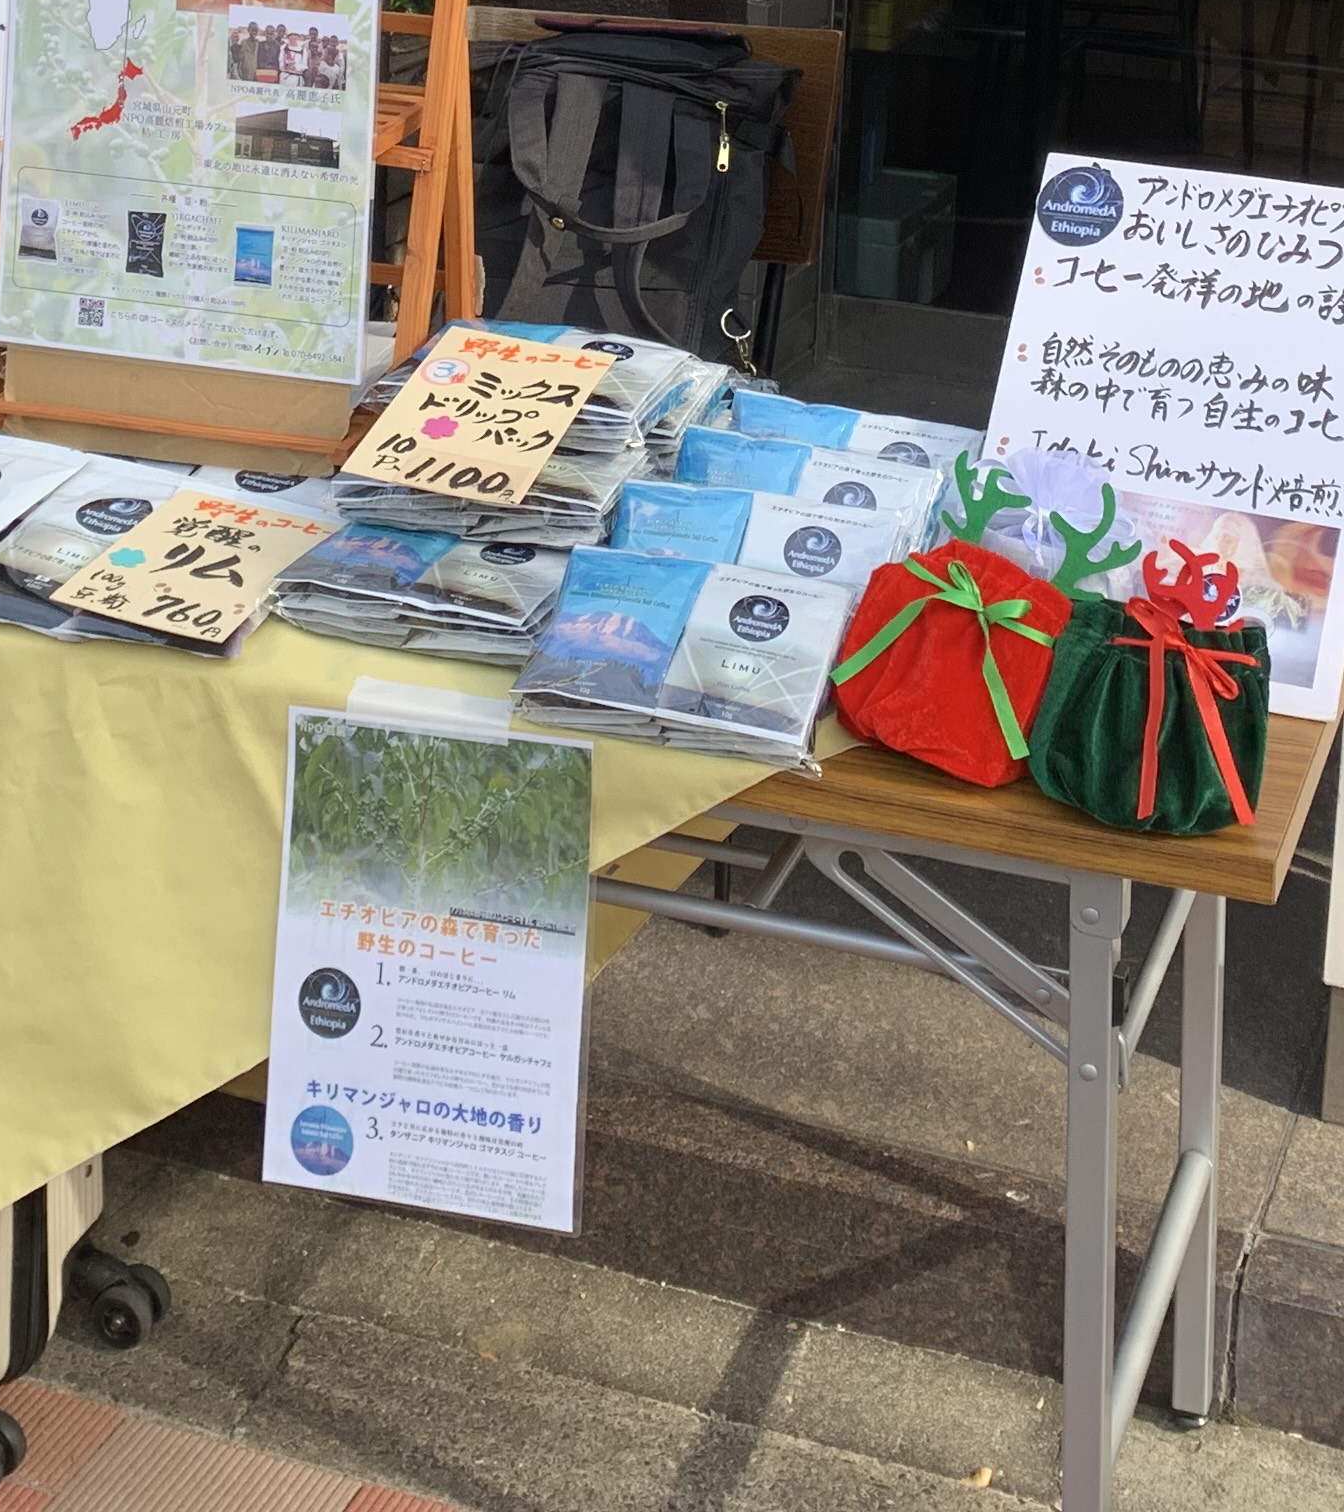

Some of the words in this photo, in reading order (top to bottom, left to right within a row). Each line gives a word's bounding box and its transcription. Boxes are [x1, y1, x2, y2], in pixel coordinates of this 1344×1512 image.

[1042, 199, 1118, 219] AndromedA
[1050, 219, 1101, 238] Ethiopia
[457, 337, 611, 370] 野生のコーヒー
[1040, 331, 1336, 404] 自然そのものの恵みの味
[467, 371, 582, 409] ミックス
[418, 391, 541, 425] ドリップ
[376, 432, 417, 454] 10
[194, 499, 335, 536] 野生のコーヒー
[148, 541, 245, 588] リム
[720, 658, 762, 676] LIMU
[320, 900, 543, 951] エチオピアの森で育った
[357, 931, 499, 968] 野生のコーヒー
[375, 961, 392, 988] 1.
[309, 1014, 348, 1031] Ethiopia
[370, 1023, 389, 1050] 2.
[306, 1079, 543, 1136] キリマンジャロの大地の香り
[365, 1115, 384, 1142] 3.
